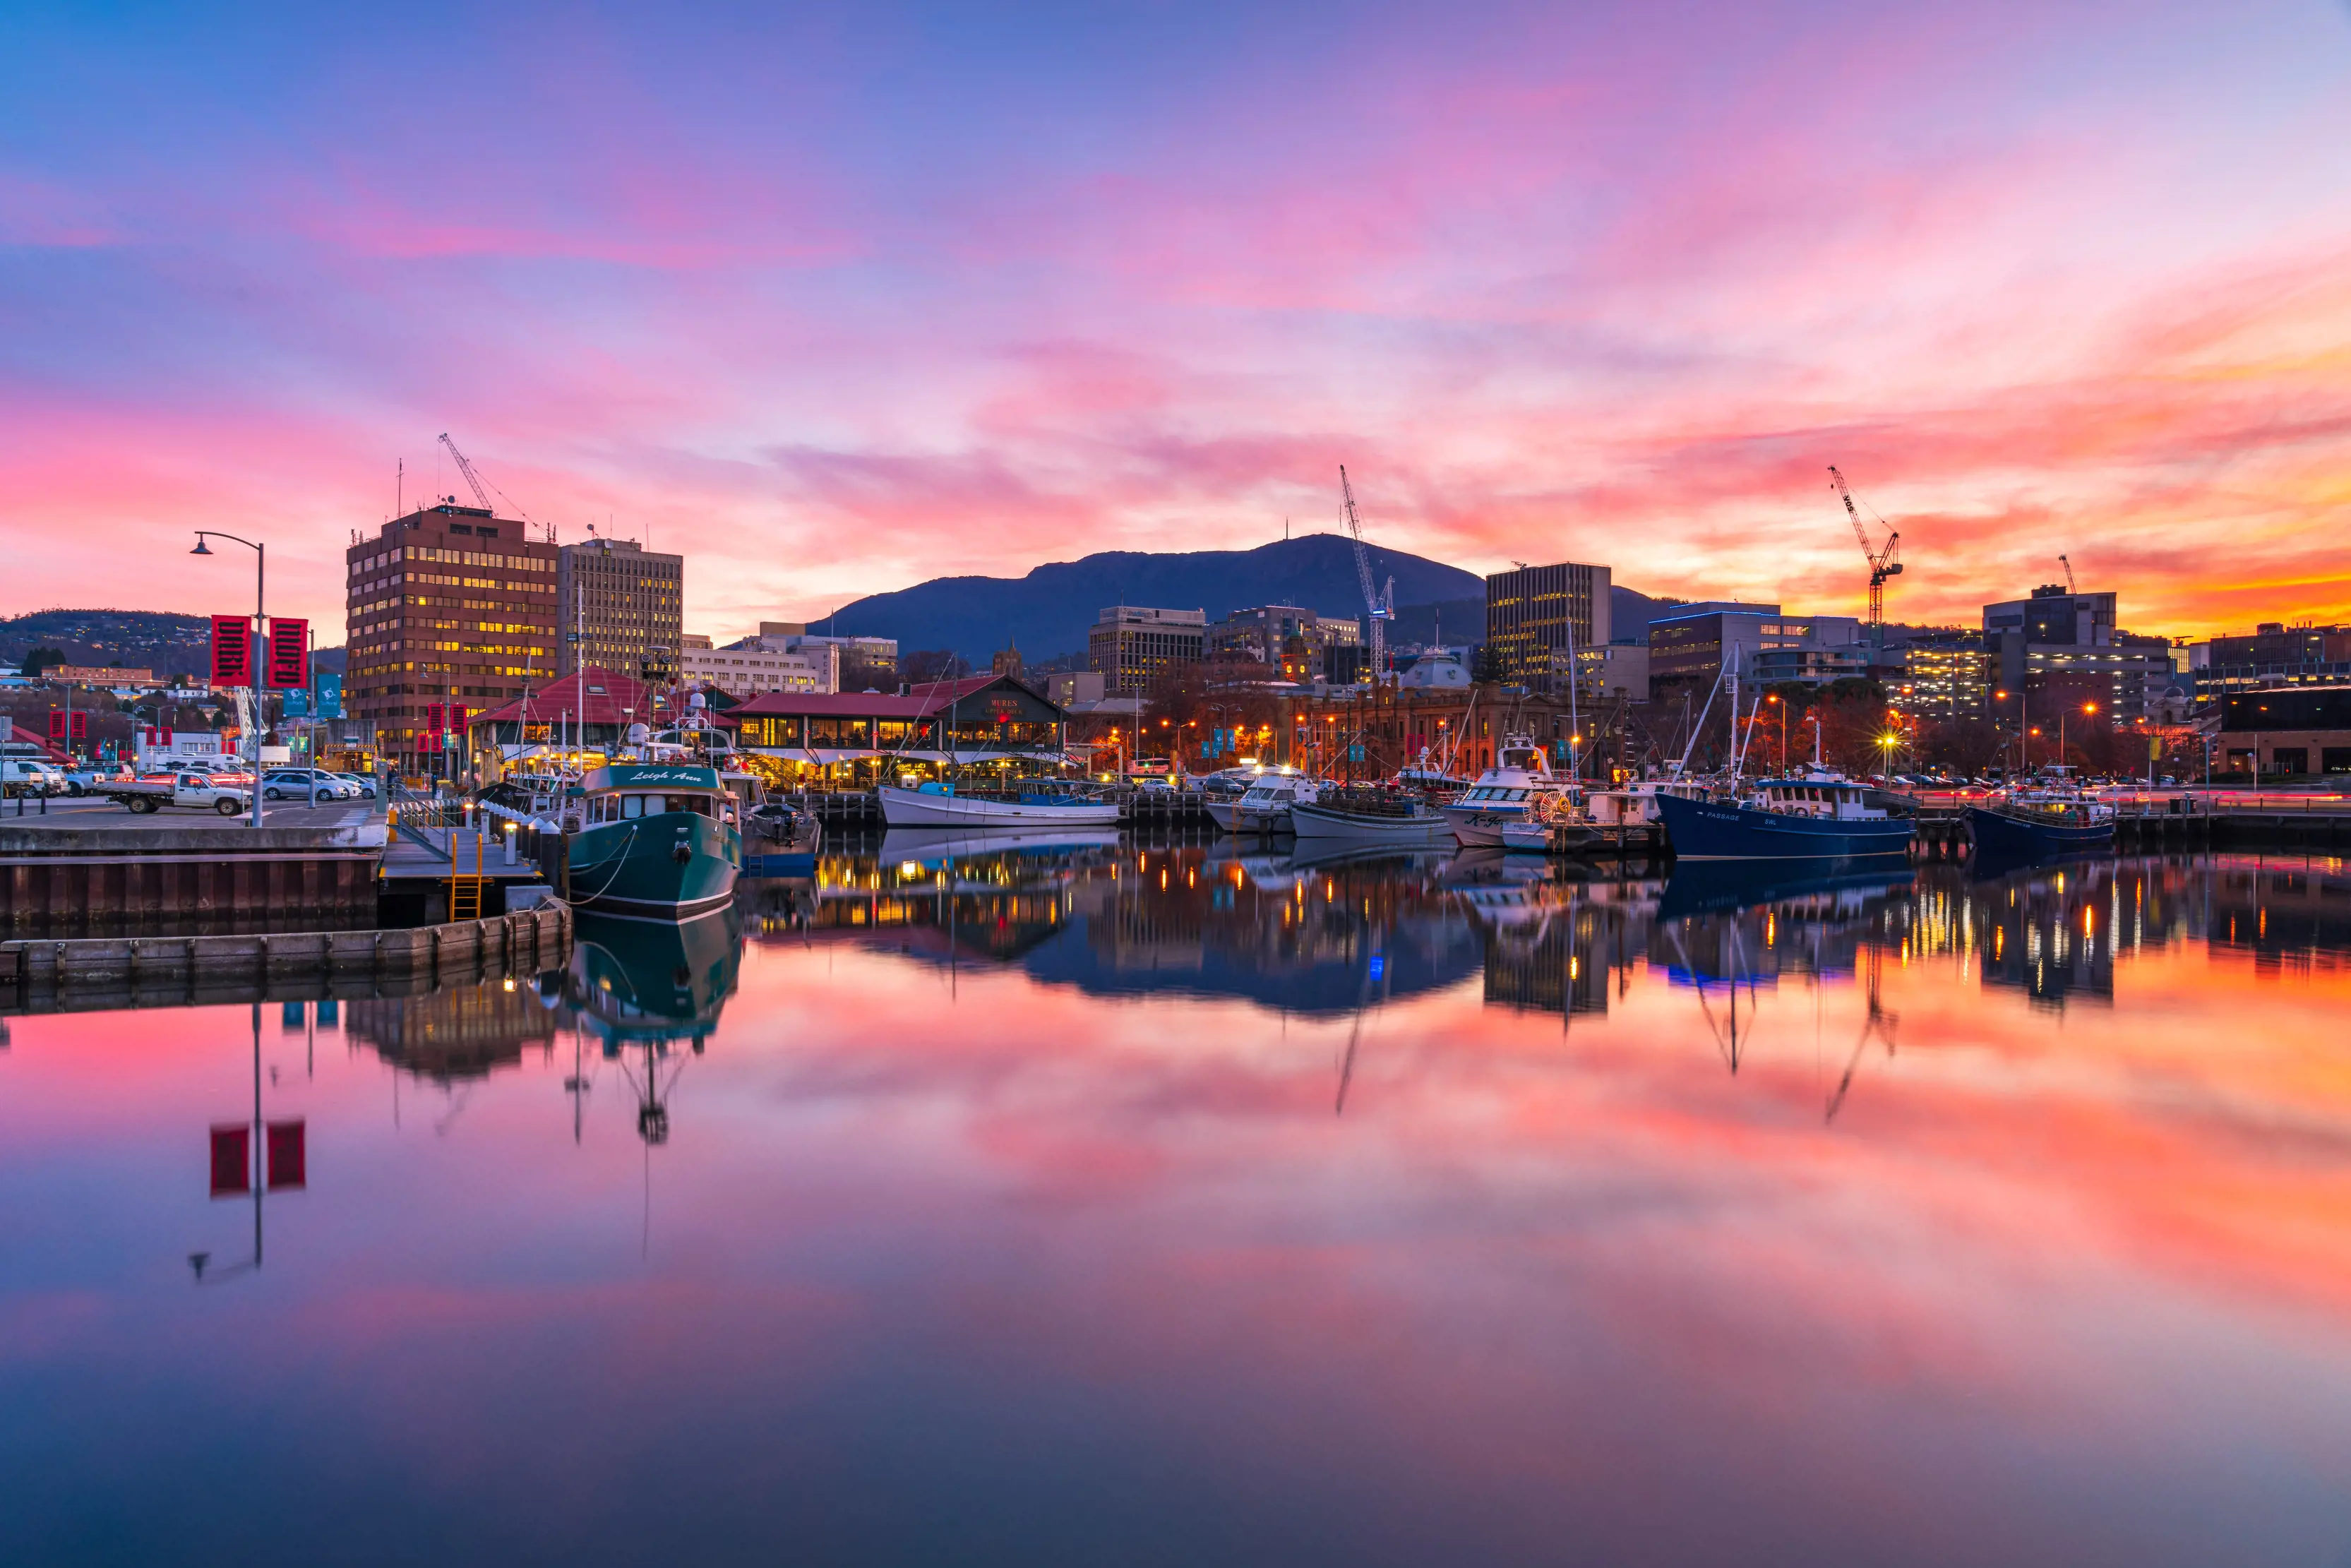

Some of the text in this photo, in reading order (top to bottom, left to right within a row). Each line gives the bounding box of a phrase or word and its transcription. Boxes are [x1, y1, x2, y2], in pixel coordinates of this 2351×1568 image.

[630, 772, 702, 782] Leigh Ann
[1707, 812, 1740, 821] PASSAGE
